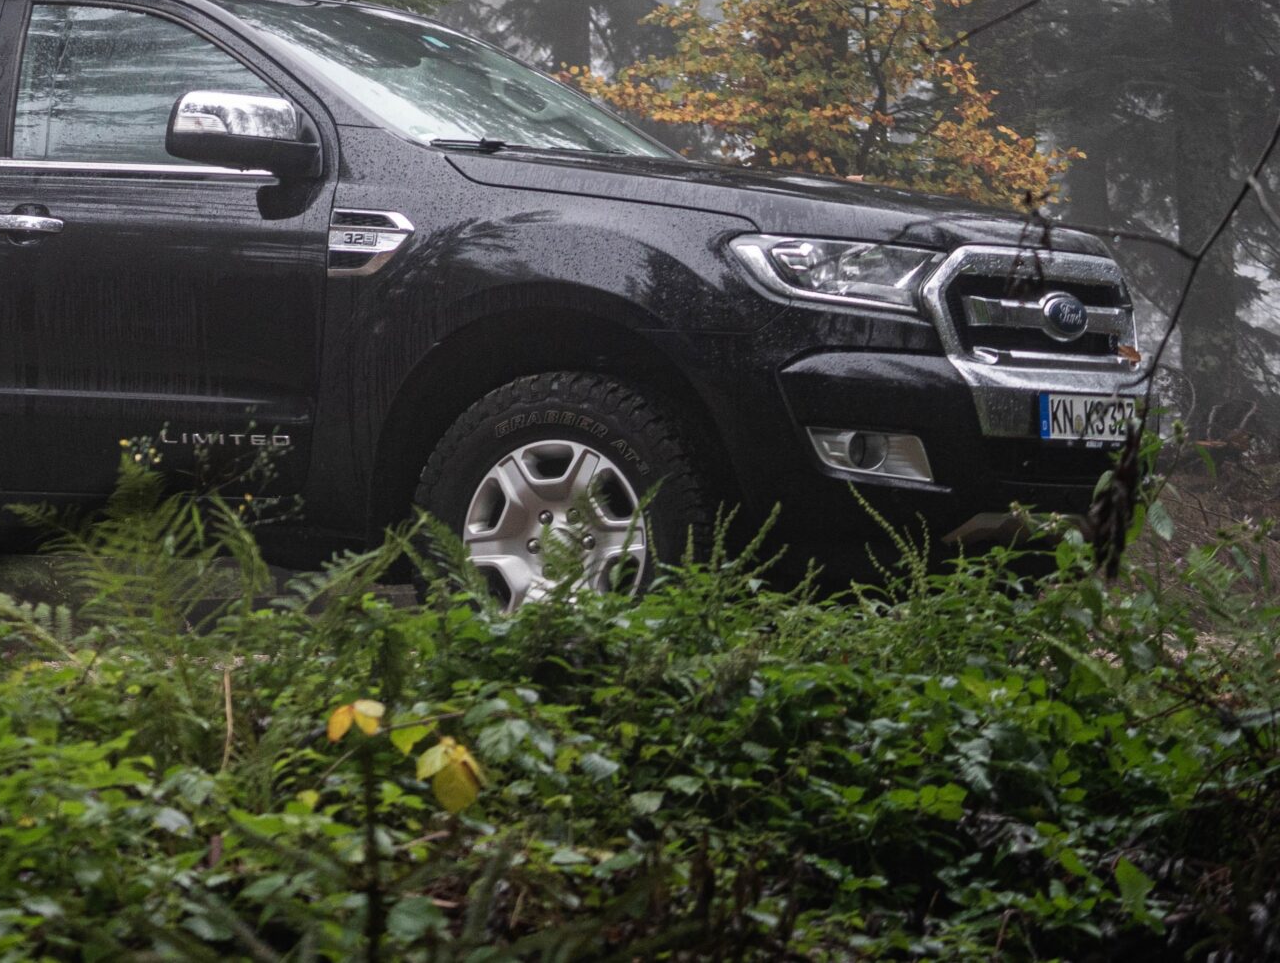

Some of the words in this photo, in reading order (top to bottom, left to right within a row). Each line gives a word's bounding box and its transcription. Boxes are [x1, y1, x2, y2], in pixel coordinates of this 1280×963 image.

[1059, 302, 1083, 325] Ford
[495, 410, 608, 438] GRABBER
[1050, 398, 1074, 434] KN
[161, 433, 290, 446] LIMITED
